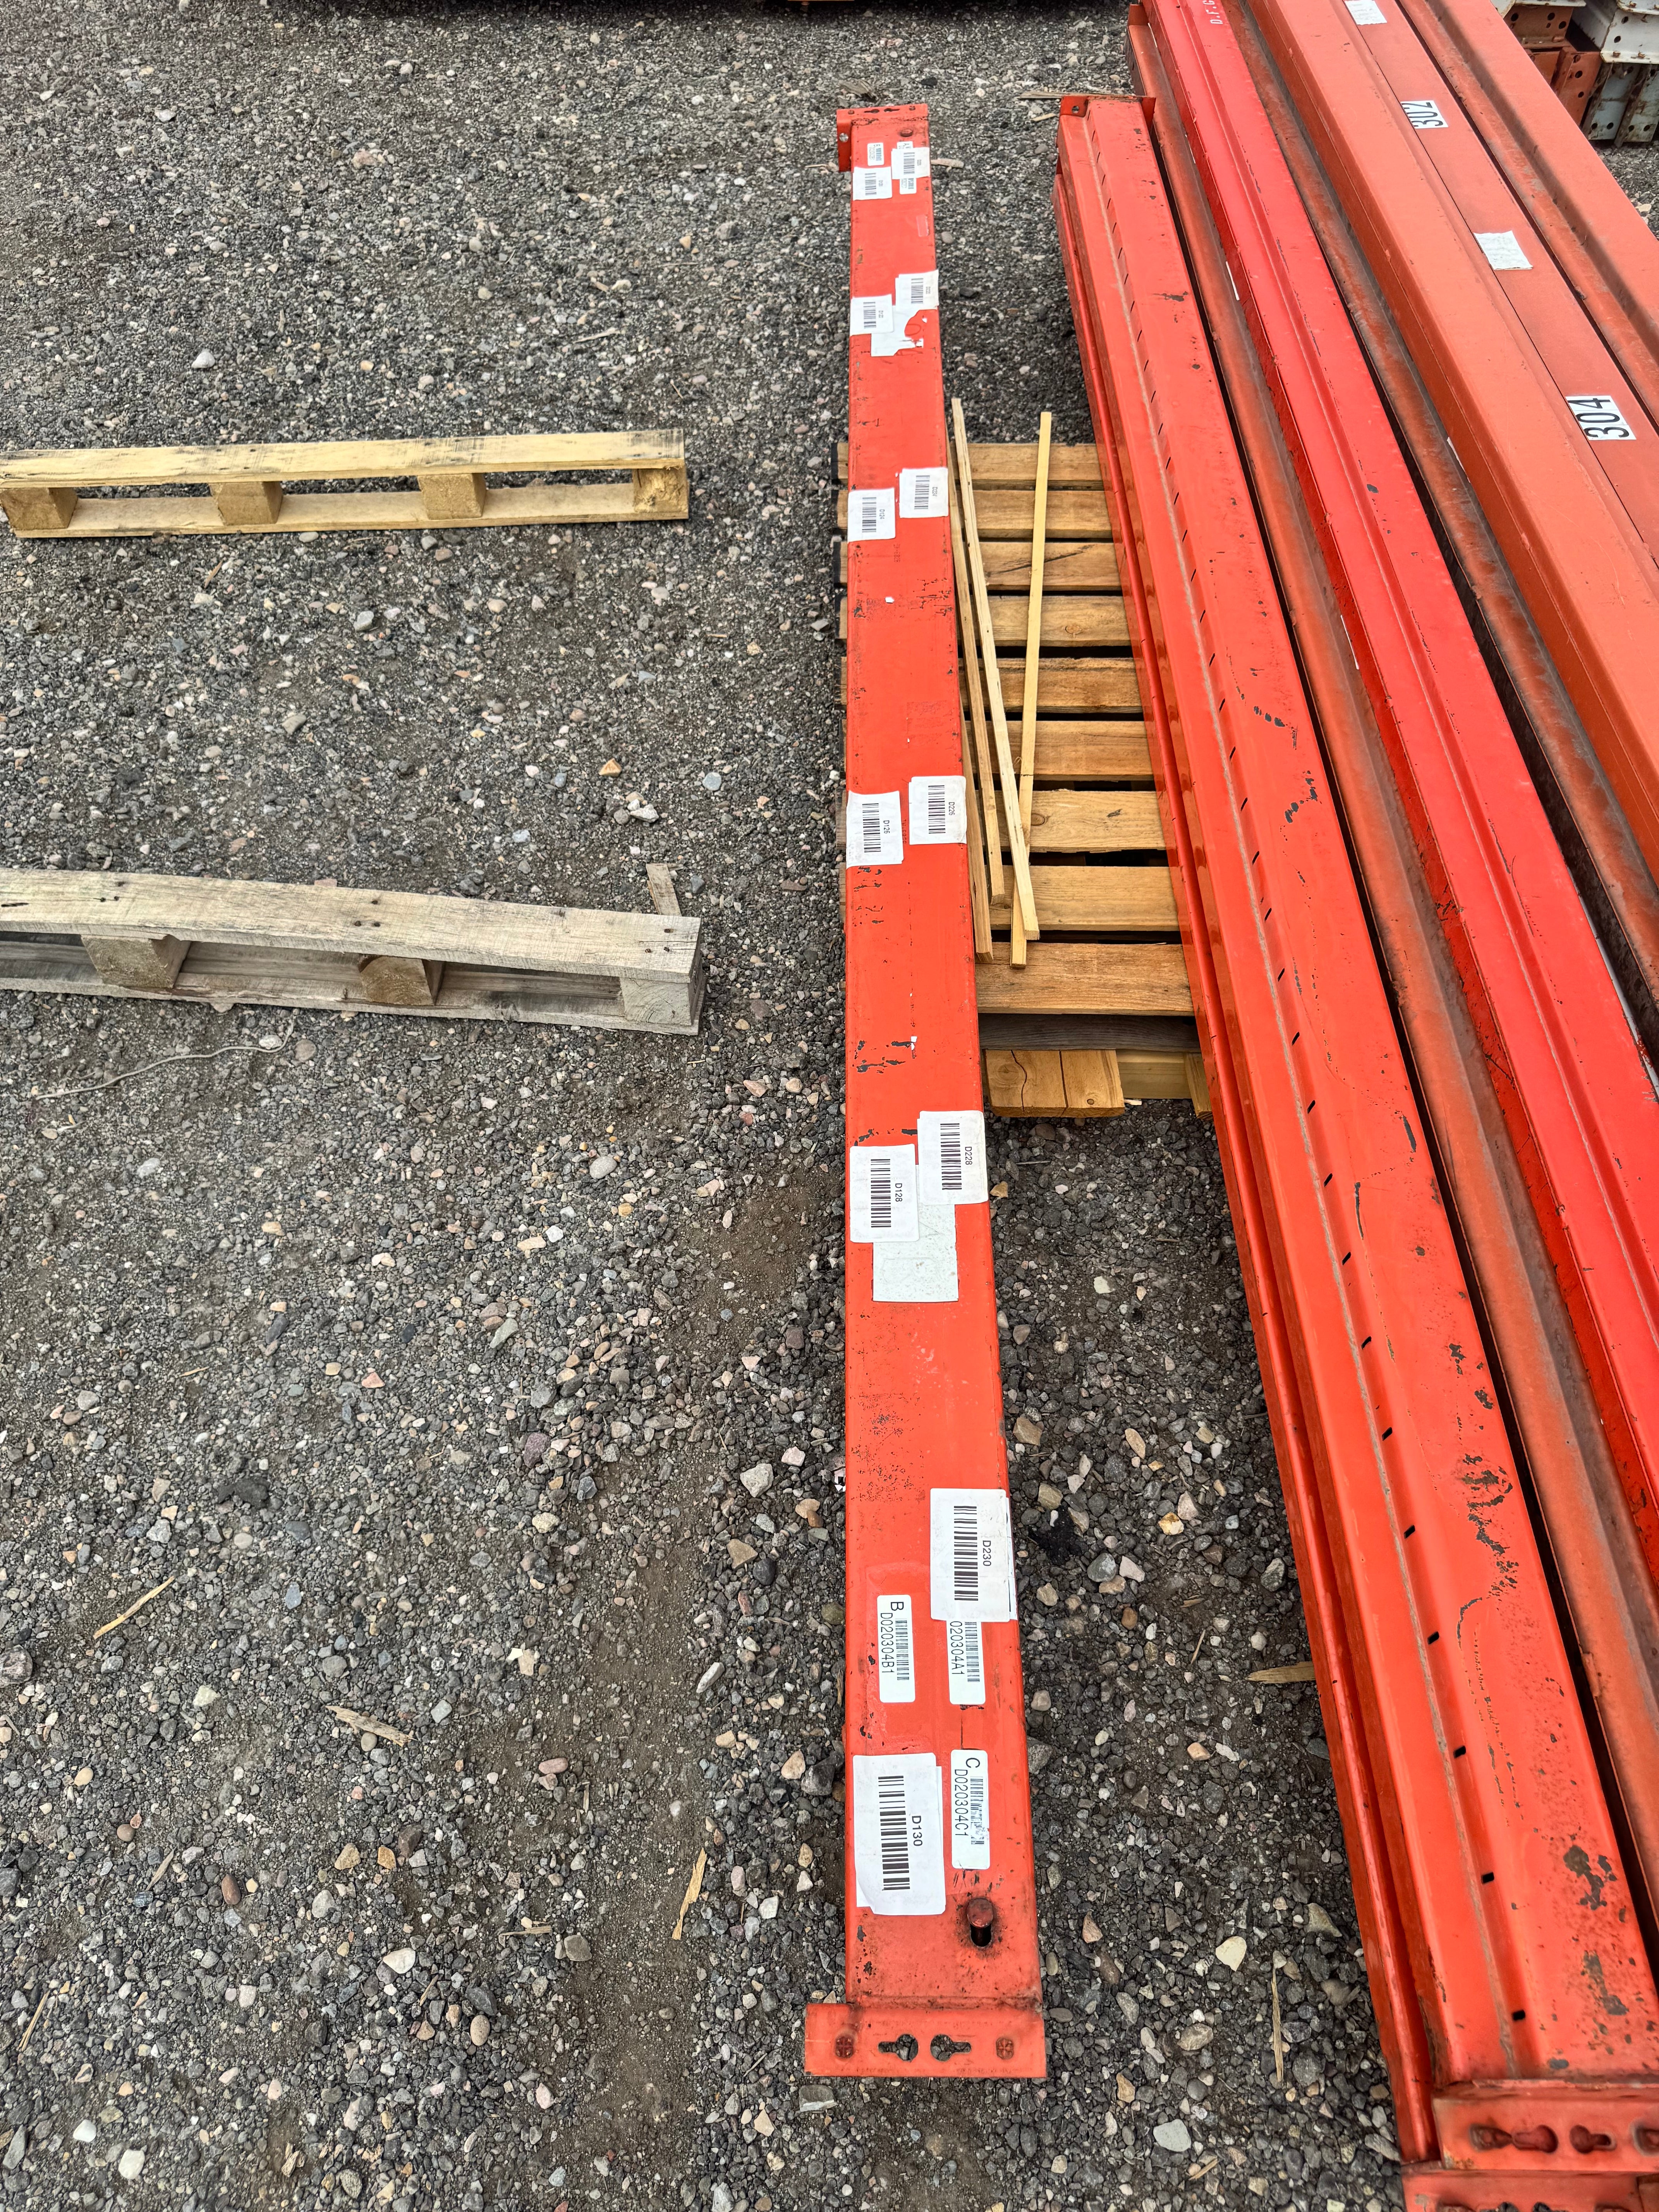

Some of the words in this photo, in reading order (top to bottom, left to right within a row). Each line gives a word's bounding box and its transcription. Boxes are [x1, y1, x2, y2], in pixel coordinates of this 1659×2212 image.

[1401, 102, 1444, 127] 302
[1568, 398, 1630, 438] 304
[965, 1146, 973, 1165] D228
[982, 1540, 991, 1566] D230
[890, 1601, 904, 1611] B
[880, 1612, 894, 1673] D020304B1
[965, 1757, 981, 1768] C
[954, 1769, 968, 1836] D020304C1
[912, 1815, 923, 1846] D130
